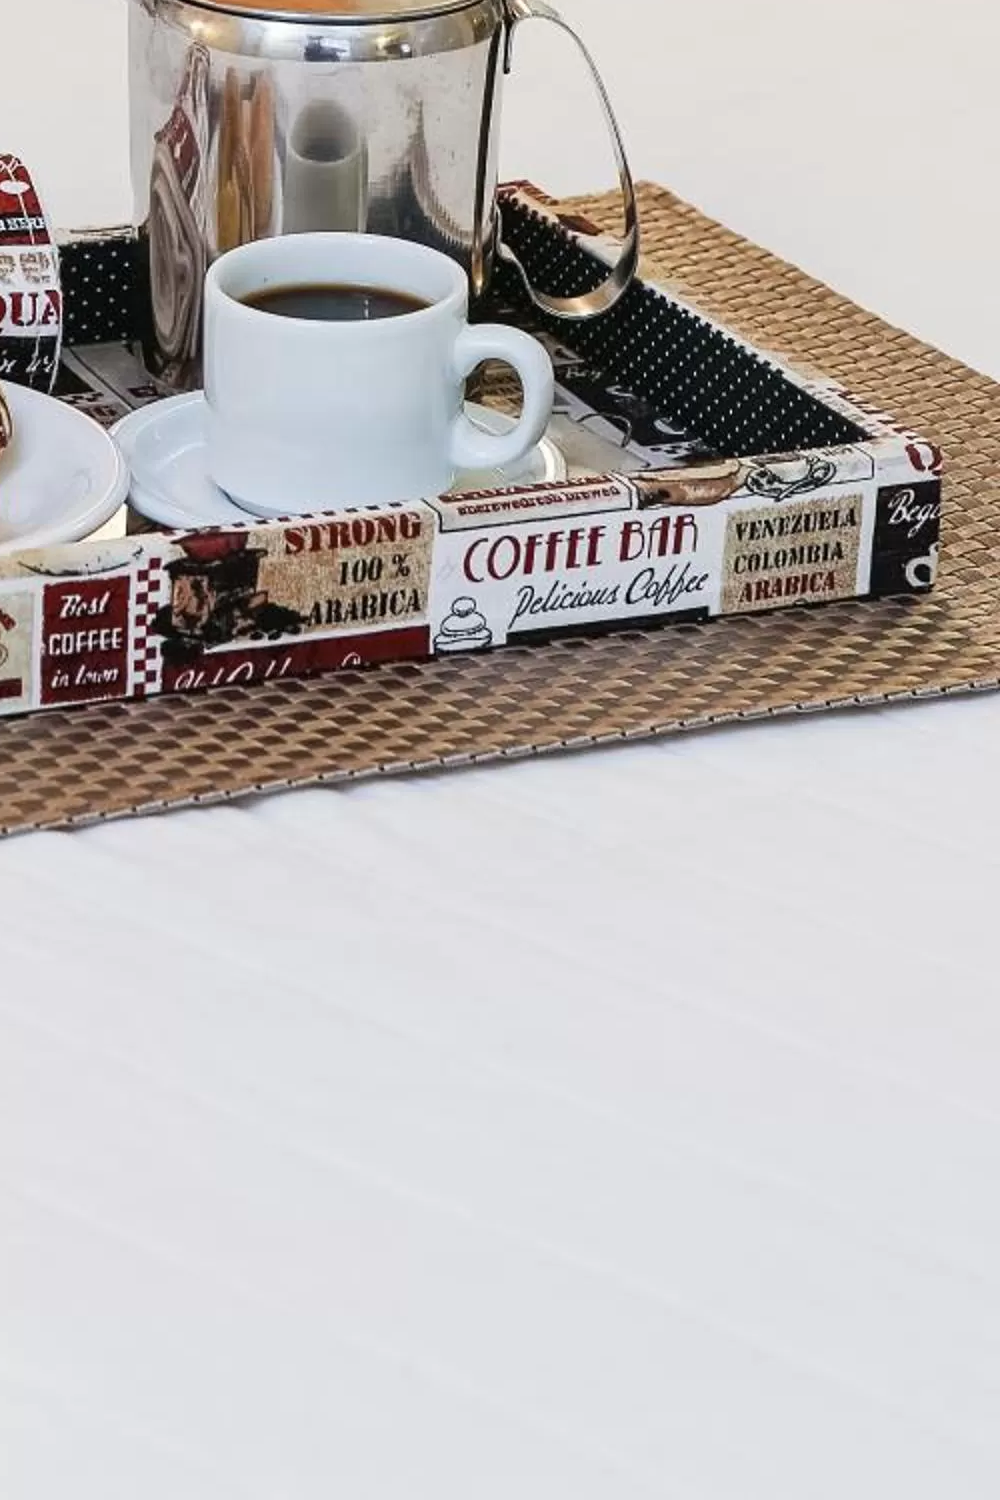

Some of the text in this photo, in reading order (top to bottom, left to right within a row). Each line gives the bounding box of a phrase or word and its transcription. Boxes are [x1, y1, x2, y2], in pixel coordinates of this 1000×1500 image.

[284, 511, 422, 552] STRONG
[734, 507, 858, 542] VENEZUELA
[463, 513, 698, 583] COFFEE BAR
[733, 541, 844, 574] COLOMBIA
[339, 555, 383, 586] 100
[625, 562, 710, 607] Coffee
[739, 570, 836, 603] ARABICA
[59, 591, 111, 619] Best
[306, 589, 422, 627] ARABICA
[49, 627, 123, 656] COFFEE
[51, 668, 70, 689] in
